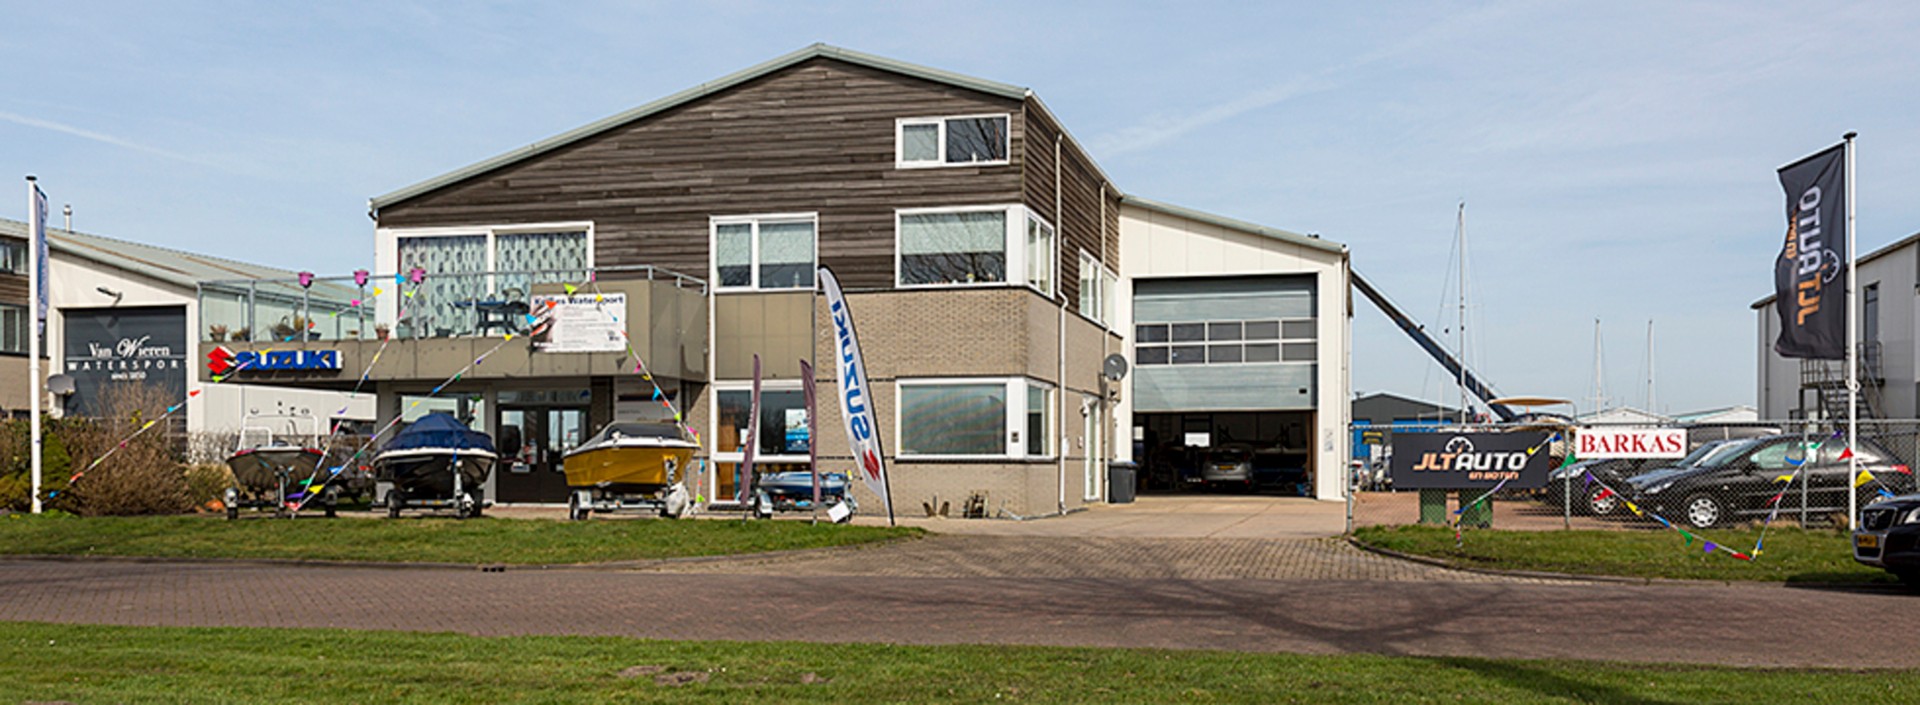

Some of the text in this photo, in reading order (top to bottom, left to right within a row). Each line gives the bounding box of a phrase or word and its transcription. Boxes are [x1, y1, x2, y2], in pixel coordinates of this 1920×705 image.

[89, 335, 170, 358] Van Wieren
[235, 350, 339, 371] SUZUKI
[1580, 433, 1682, 453] BARKAS
